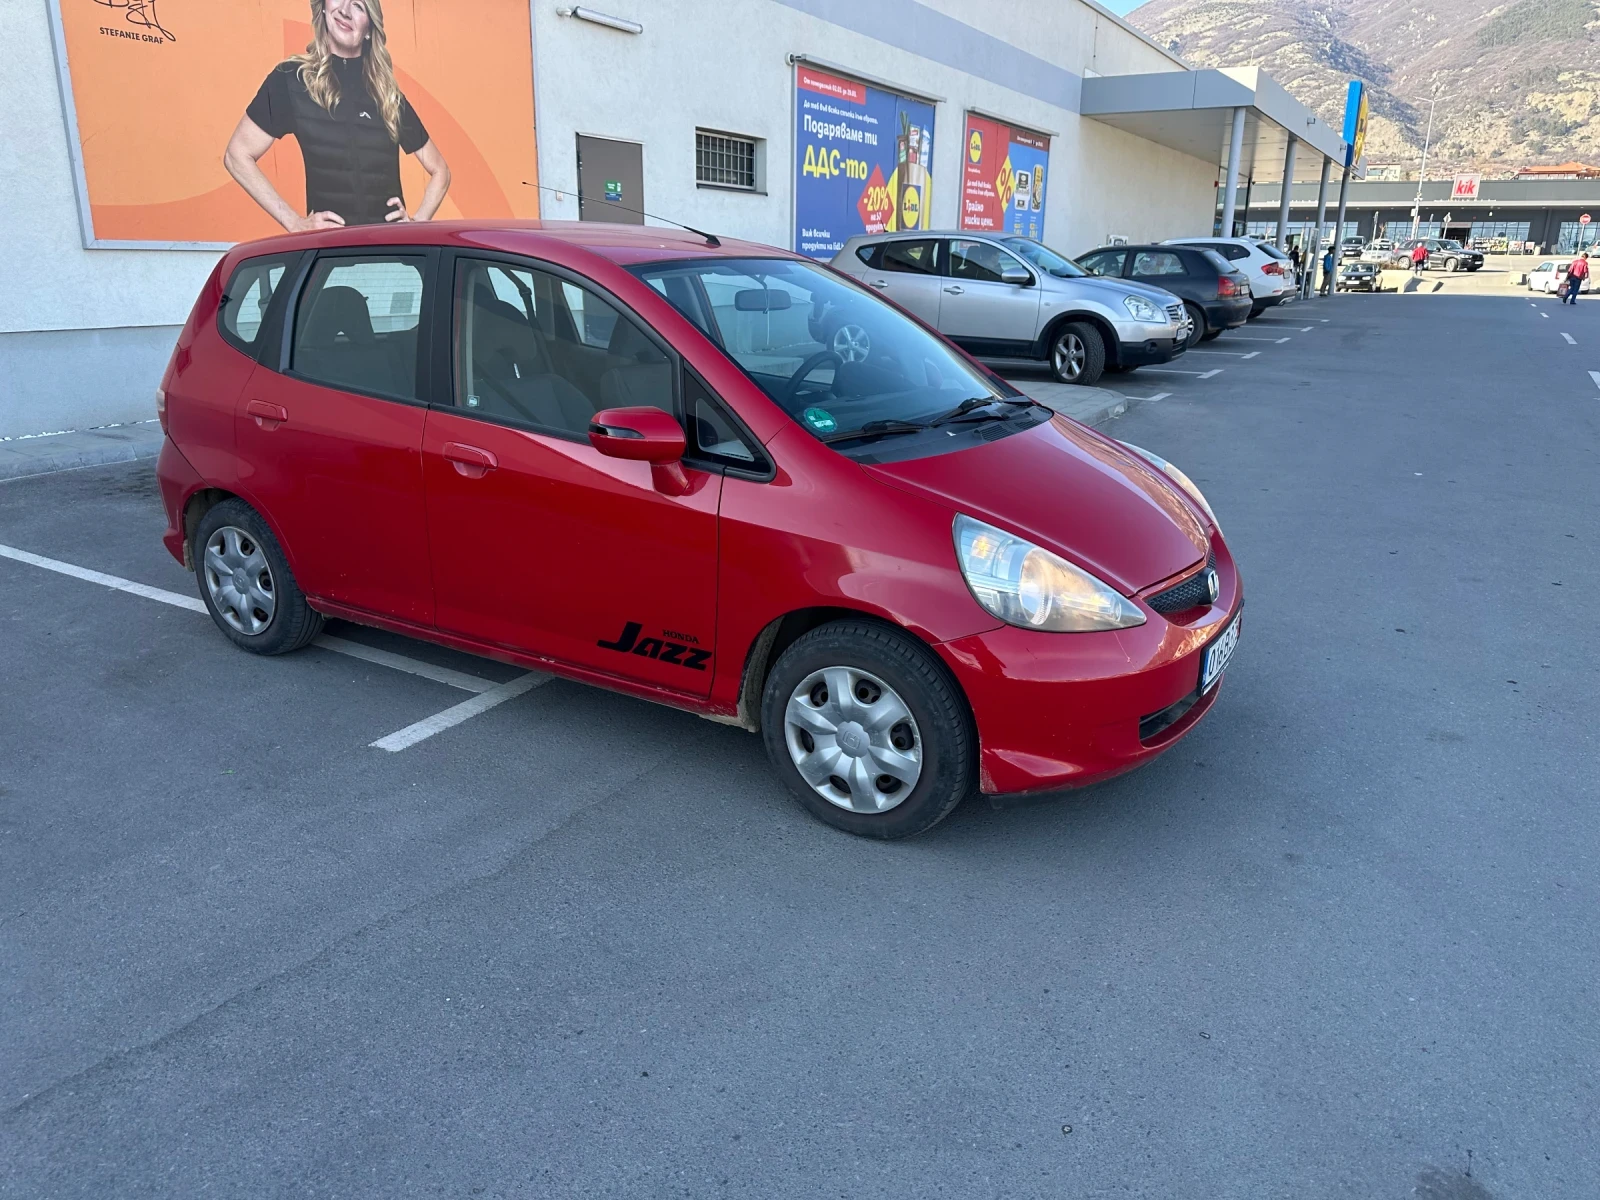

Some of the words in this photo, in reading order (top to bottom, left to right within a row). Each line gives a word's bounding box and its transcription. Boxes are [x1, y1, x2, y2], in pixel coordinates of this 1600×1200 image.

[100, 27, 140, 41] STEFANIE
[142, 34, 164, 44] GRAF
[804, 114, 863, 142] Подаряваме
[864, 131, 877, 146] ти
[803, 144, 868, 180] ДДС-то
[864, 186, 888, 211] -20%
[966, 200, 984, 213] Трайно
[802, 242, 826, 252] продукти
[663, 629, 700, 644] HONDA
